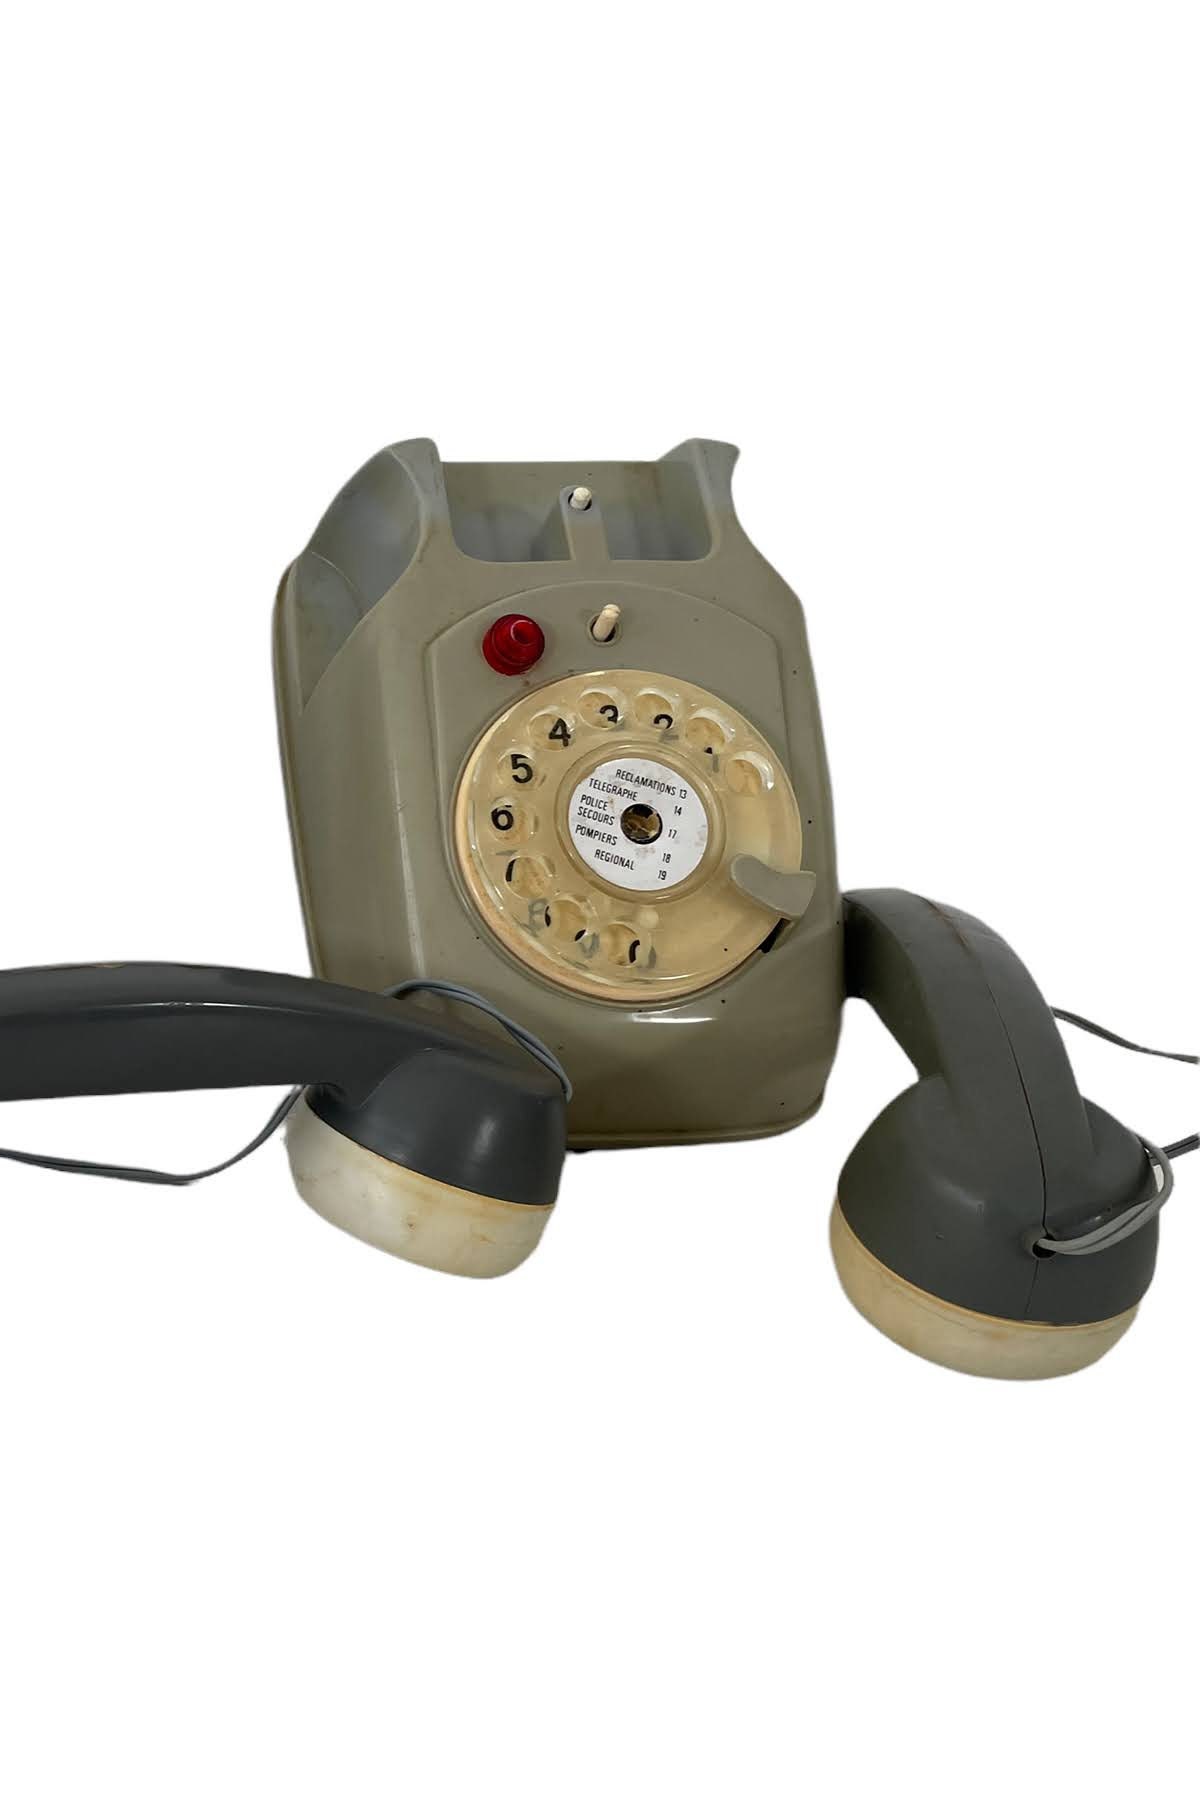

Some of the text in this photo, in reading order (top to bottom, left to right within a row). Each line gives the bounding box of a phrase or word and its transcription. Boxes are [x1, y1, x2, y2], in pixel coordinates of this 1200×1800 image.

[549, 717, 572, 747] 4
[510, 753, 534, 784] 5
[615, 769, 688, 799] RECLAMATIONS 13
[580, 794, 609, 811] POLICE
[588, 778, 682, 816] TELEGRAPHE 14
[491, 804, 515, 831] 6
[577, 806, 677, 839] SECOURS 17
[575, 824, 671, 863] POMPIERS 18
[594, 849, 667, 880] REGIONAL 19
